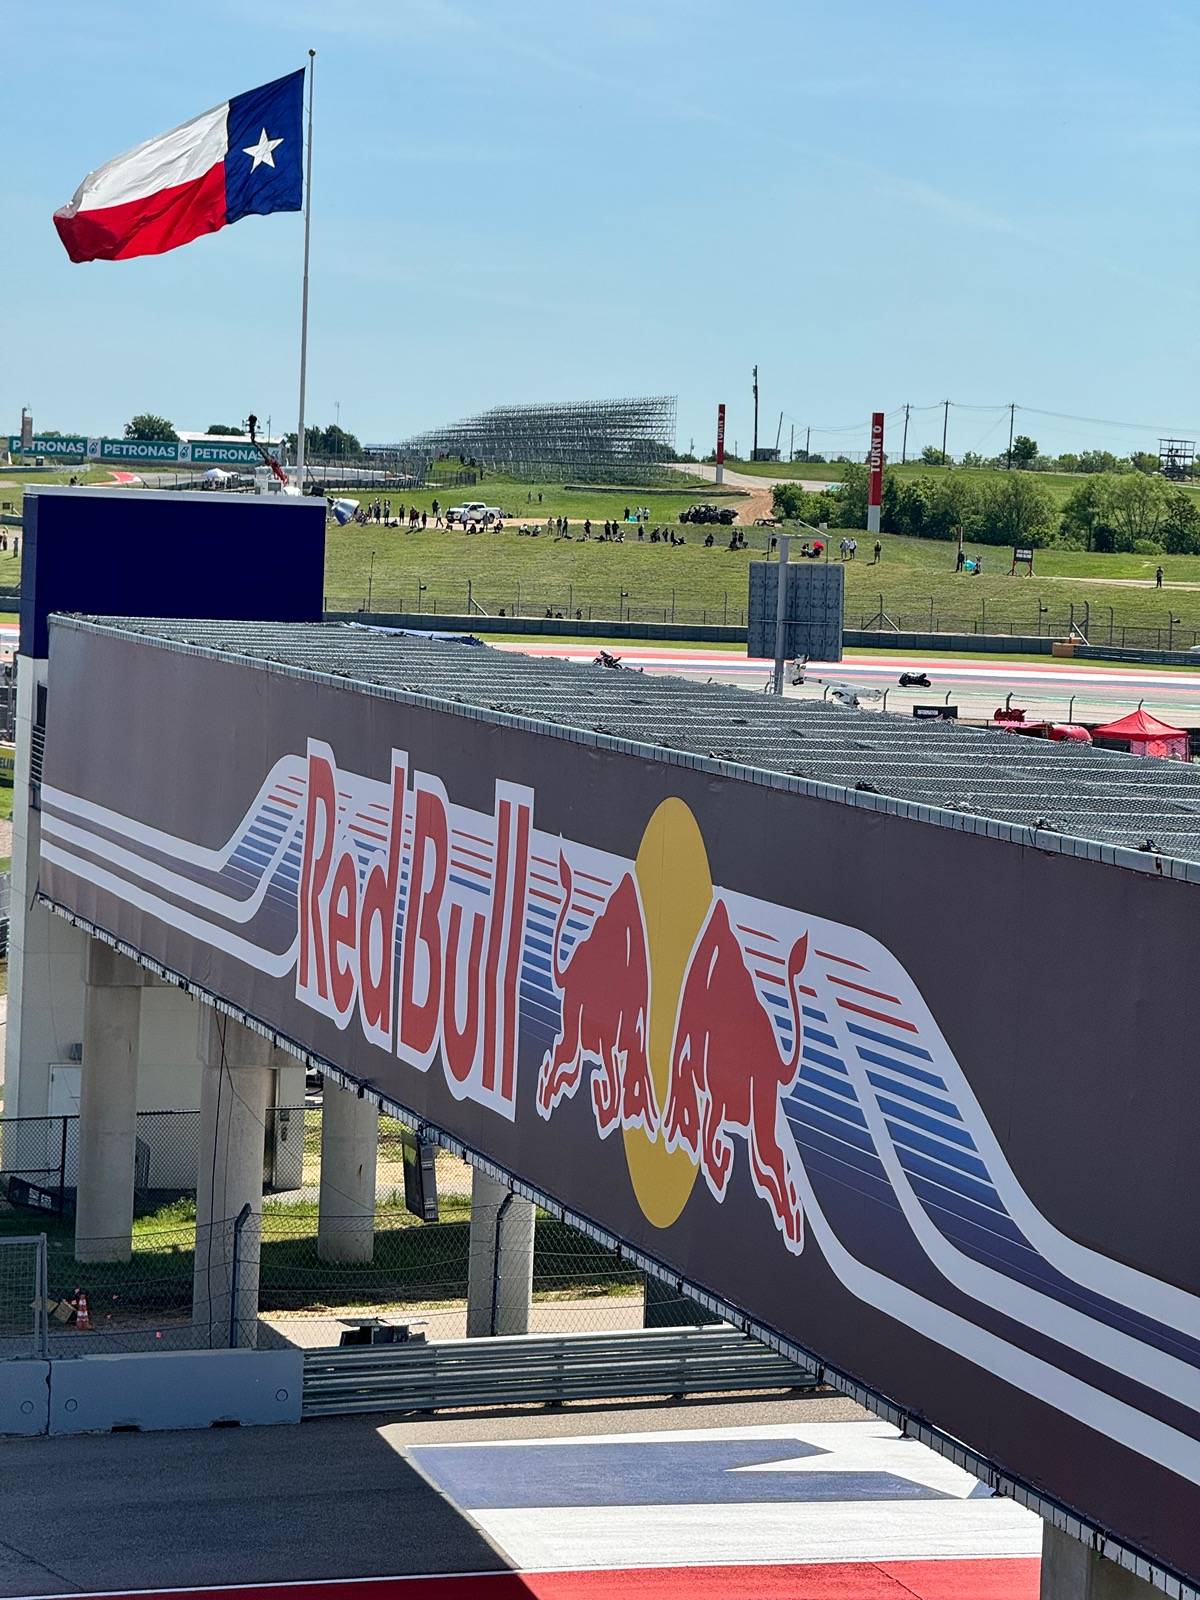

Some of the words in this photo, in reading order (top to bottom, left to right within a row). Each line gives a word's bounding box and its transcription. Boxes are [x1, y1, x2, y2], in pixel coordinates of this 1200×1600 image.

[12, 440, 85, 453] PTRONAS
[104, 443, 176, 457] PETRONAS
[870, 438, 881, 473] TURN
